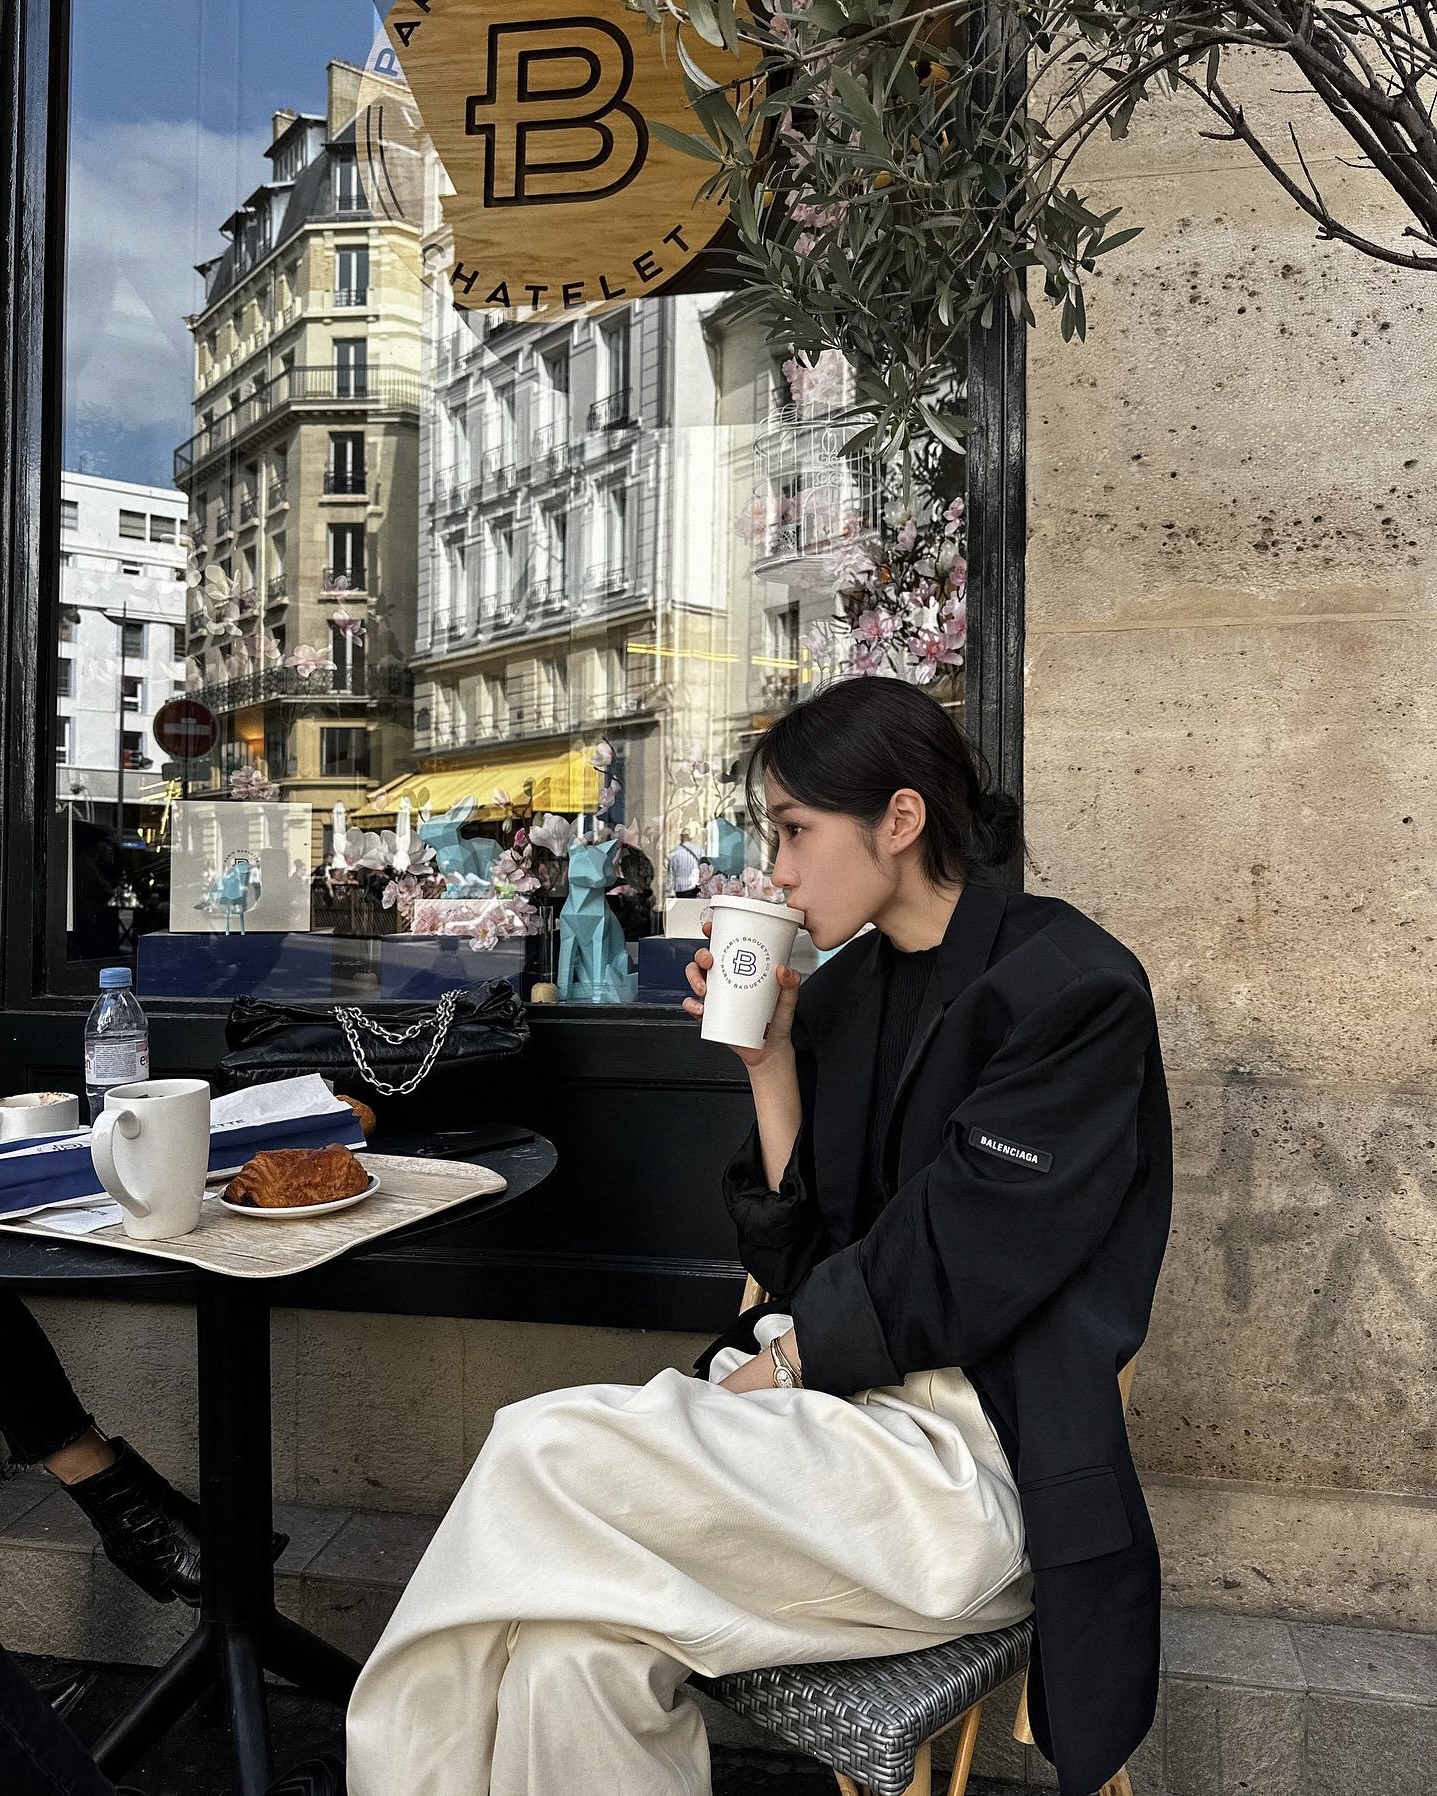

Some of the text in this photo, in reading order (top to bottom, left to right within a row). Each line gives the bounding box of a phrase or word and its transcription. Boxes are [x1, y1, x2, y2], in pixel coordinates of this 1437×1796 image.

[421, 224, 690, 311] CHATELET
[723, 936, 770, 961] PARIS BAGUETTE
[720, 964, 768, 990] PARIS BAGUETTE
[980, 1135, 1038, 1164] BALENCIAGA
